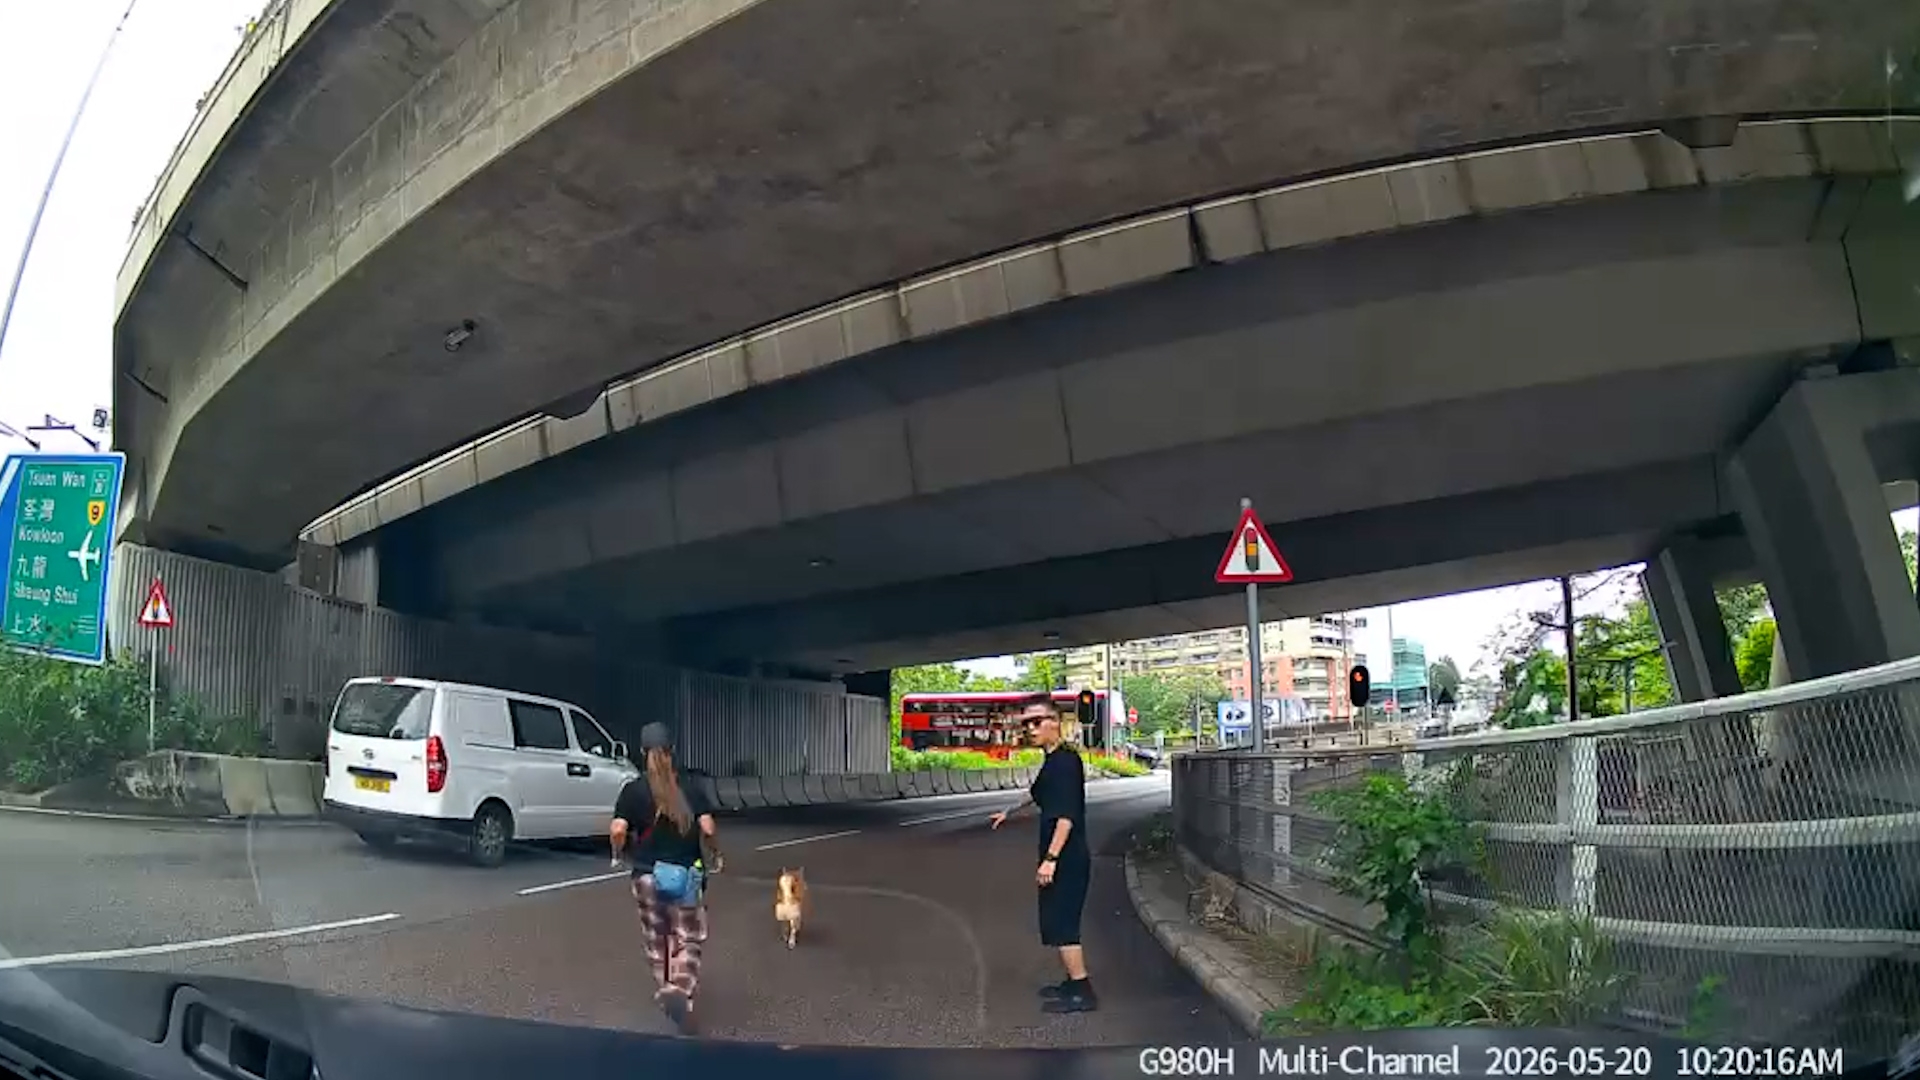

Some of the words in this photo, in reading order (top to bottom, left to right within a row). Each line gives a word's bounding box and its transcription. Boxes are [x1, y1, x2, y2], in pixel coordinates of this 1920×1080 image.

[28, 469, 57, 486] Tsuen
[62, 471, 86, 488] Wan
[23, 497, 55, 522] 荃灣
[91, 505, 100, 521] 9
[19, 525, 64, 544] Kowloon
[16, 553, 48, 579] 九龍
[13, 581, 51, 606] Sheung
[54, 585, 79, 605] Shui
[10, 611, 44, 636] 上水
